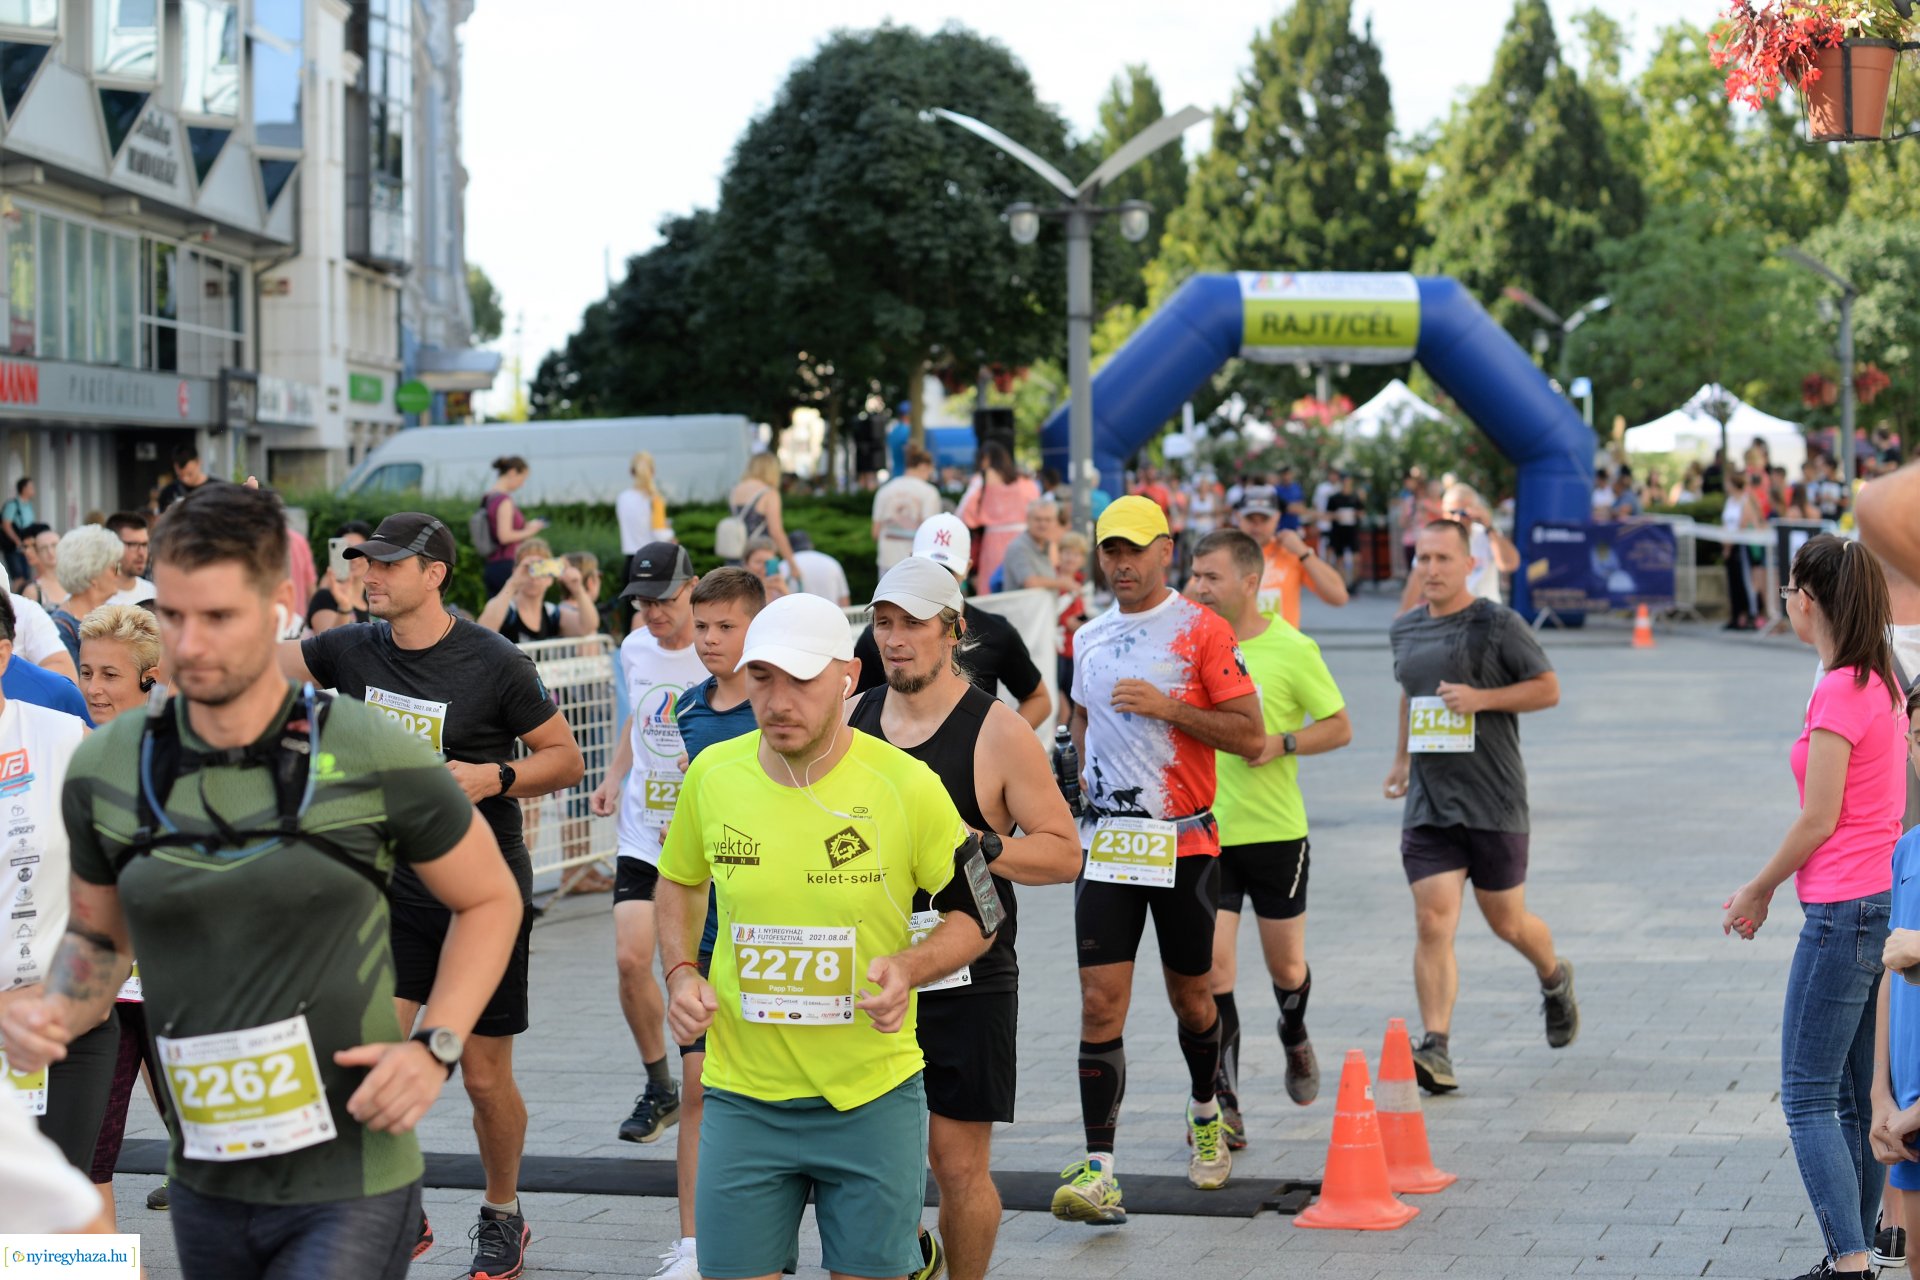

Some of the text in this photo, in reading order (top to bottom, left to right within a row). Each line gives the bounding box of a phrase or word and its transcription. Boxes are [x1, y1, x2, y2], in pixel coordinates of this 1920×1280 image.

[1261, 307, 1400, 337] RAJT/CÉL
[934, 529, 951, 546] NY
[713, 836, 761, 856] vektor
[1097, 831, 1167, 857] 2302
[714, 856, 759, 865] PRINT
[807, 872, 887, 885] kelet-solar
[758, 934, 803, 942] FUTÓFESZTIVÁL
[740, 947, 840, 982] 2278
[768, 984, 804, 993] Papp Tibor
[173, 1053, 301, 1108] 2262
